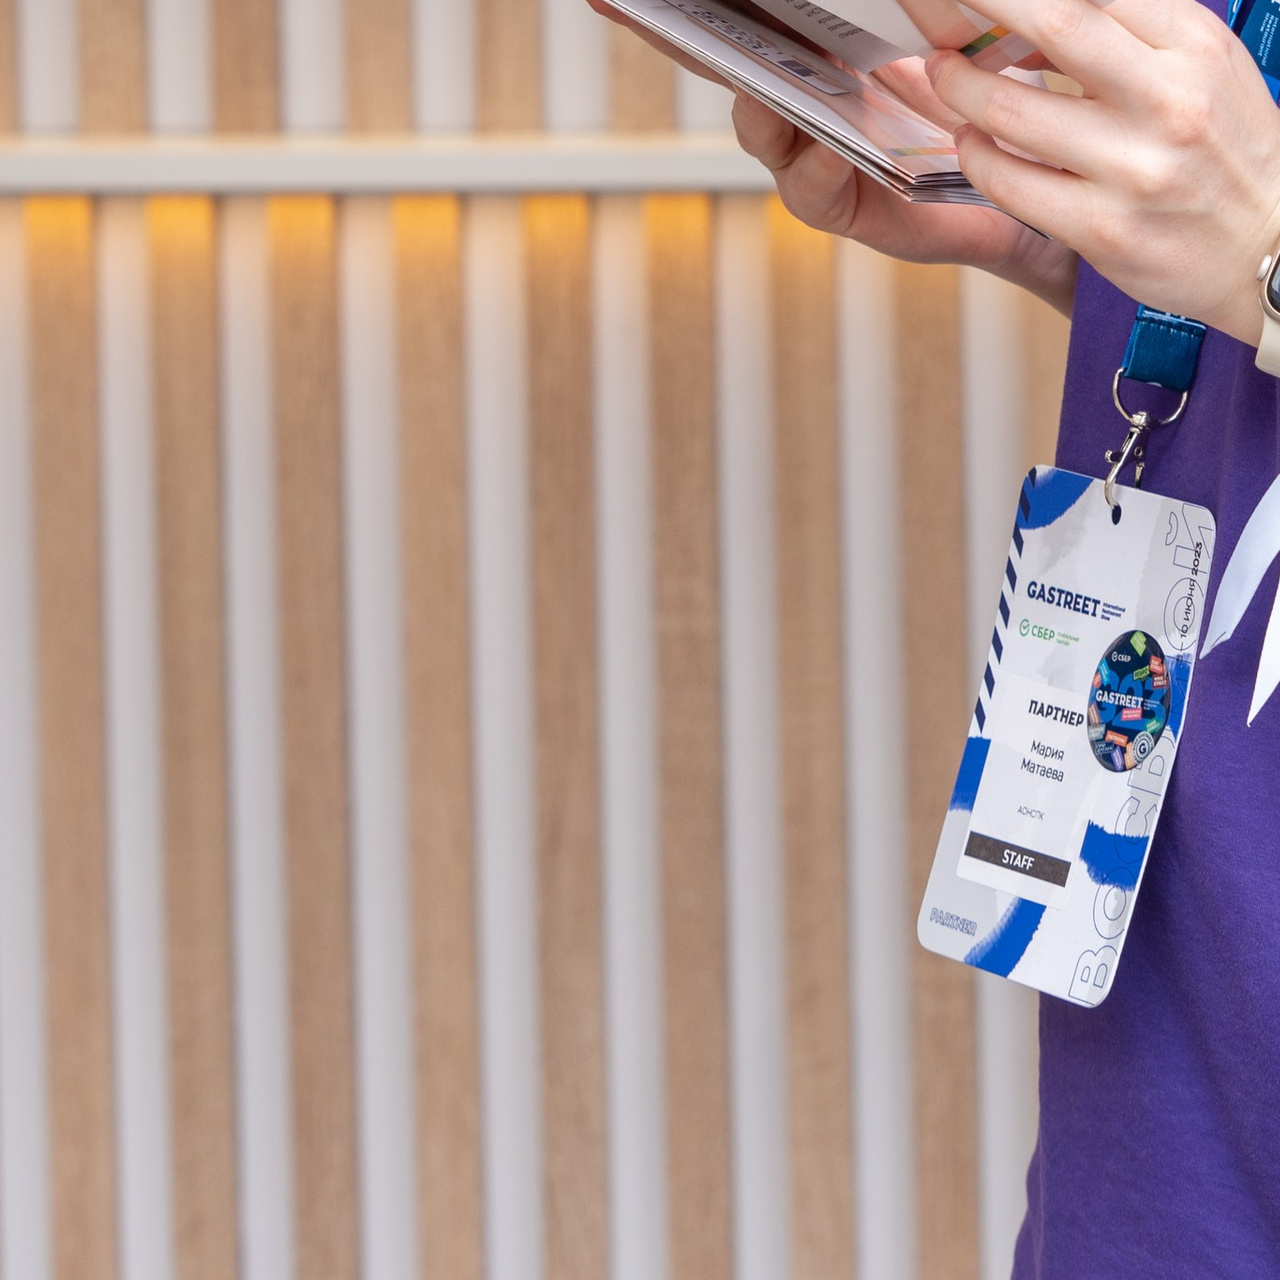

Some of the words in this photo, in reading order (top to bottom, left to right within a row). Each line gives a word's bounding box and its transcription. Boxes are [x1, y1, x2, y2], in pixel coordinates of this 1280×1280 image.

[1191, 541, 1203, 577] 2023
[1027, 580, 1101, 617] GASTREET
[1183, 578, 1197, 623] ИЮНЯ
[1031, 625, 1055, 641] СБЕР
[1180, 624, 1189, 639] 10
[1095, 689, 1144, 709] GASTREET
[1028, 700, 1084, 727] ПАРТНЕР
[1030, 740, 1065, 761] Мария
[1139, 743, 1147, 755] G
[1021, 758, 1064, 782] Матаева
[1002, 849, 1035, 870] STAFF
[929, 907, 978, 937] PARTNER
